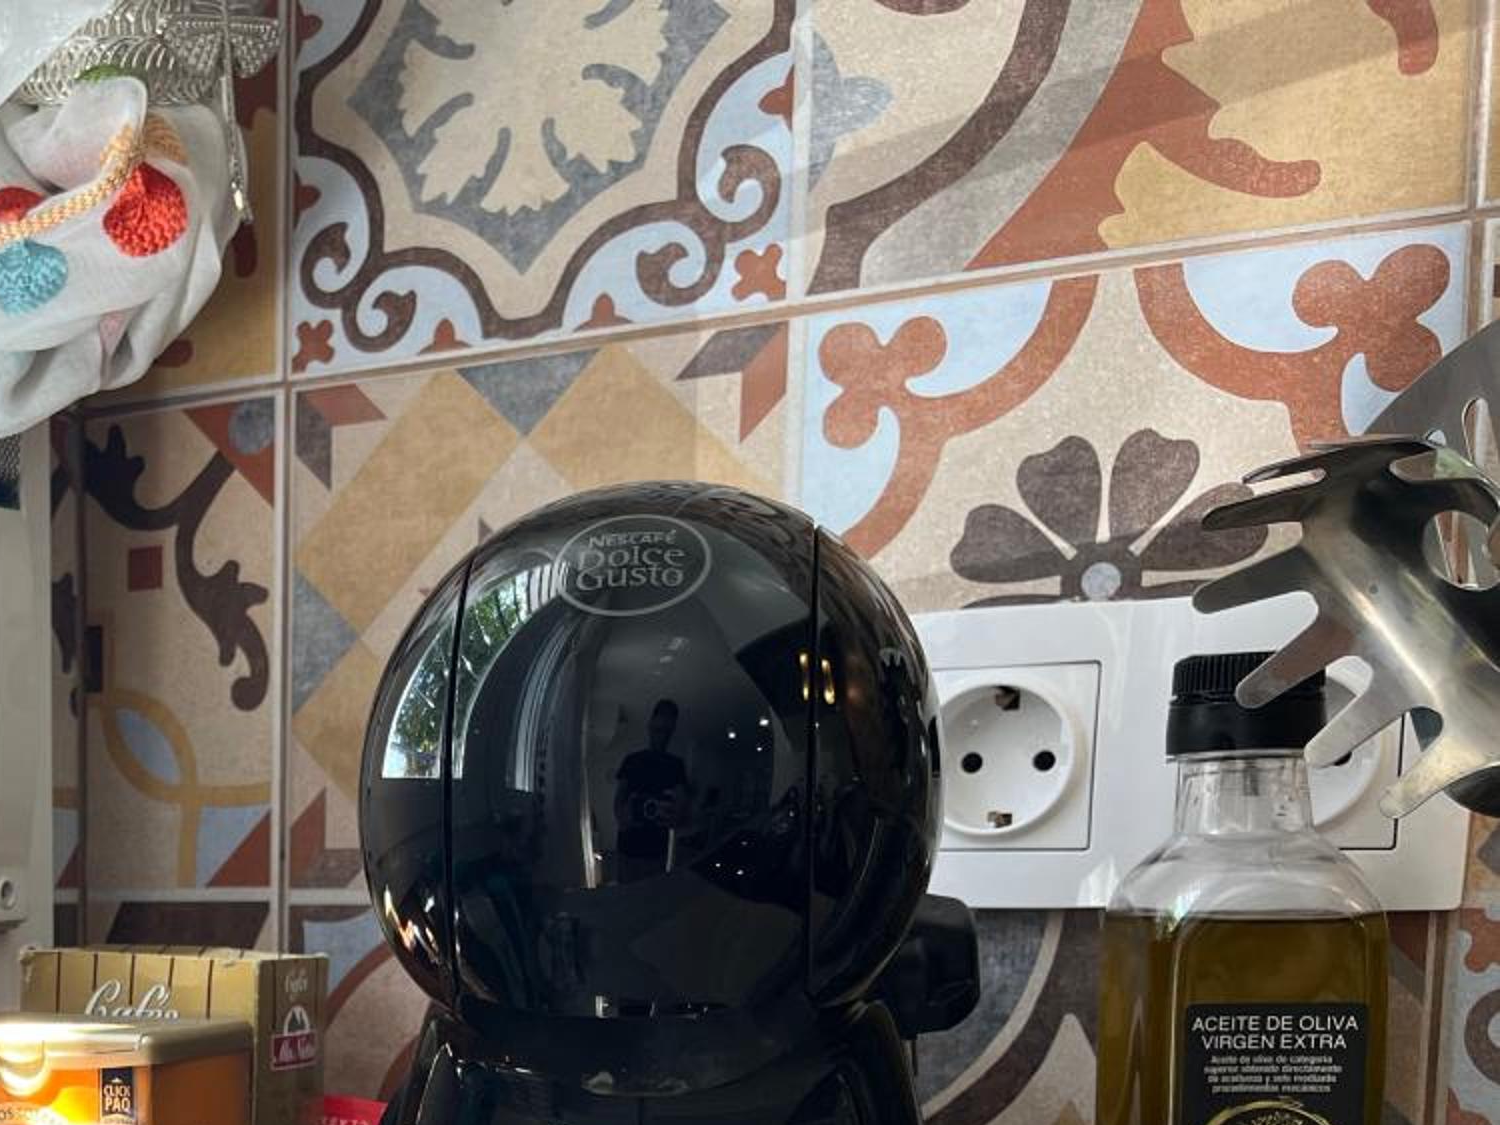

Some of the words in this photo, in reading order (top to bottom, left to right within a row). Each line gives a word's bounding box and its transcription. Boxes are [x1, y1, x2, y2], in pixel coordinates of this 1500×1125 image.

[1191, 1015, 1260, 1032] ACEITE
[1266, 1015, 1294, 1031] DE
[1299, 1015, 1359, 1031] OLIVA
[1201, 1034, 1275, 1050] VIRGEN
[1280, 1034, 1347, 1050] EXTRA
[104, 1098, 131, 1114] PAQ
